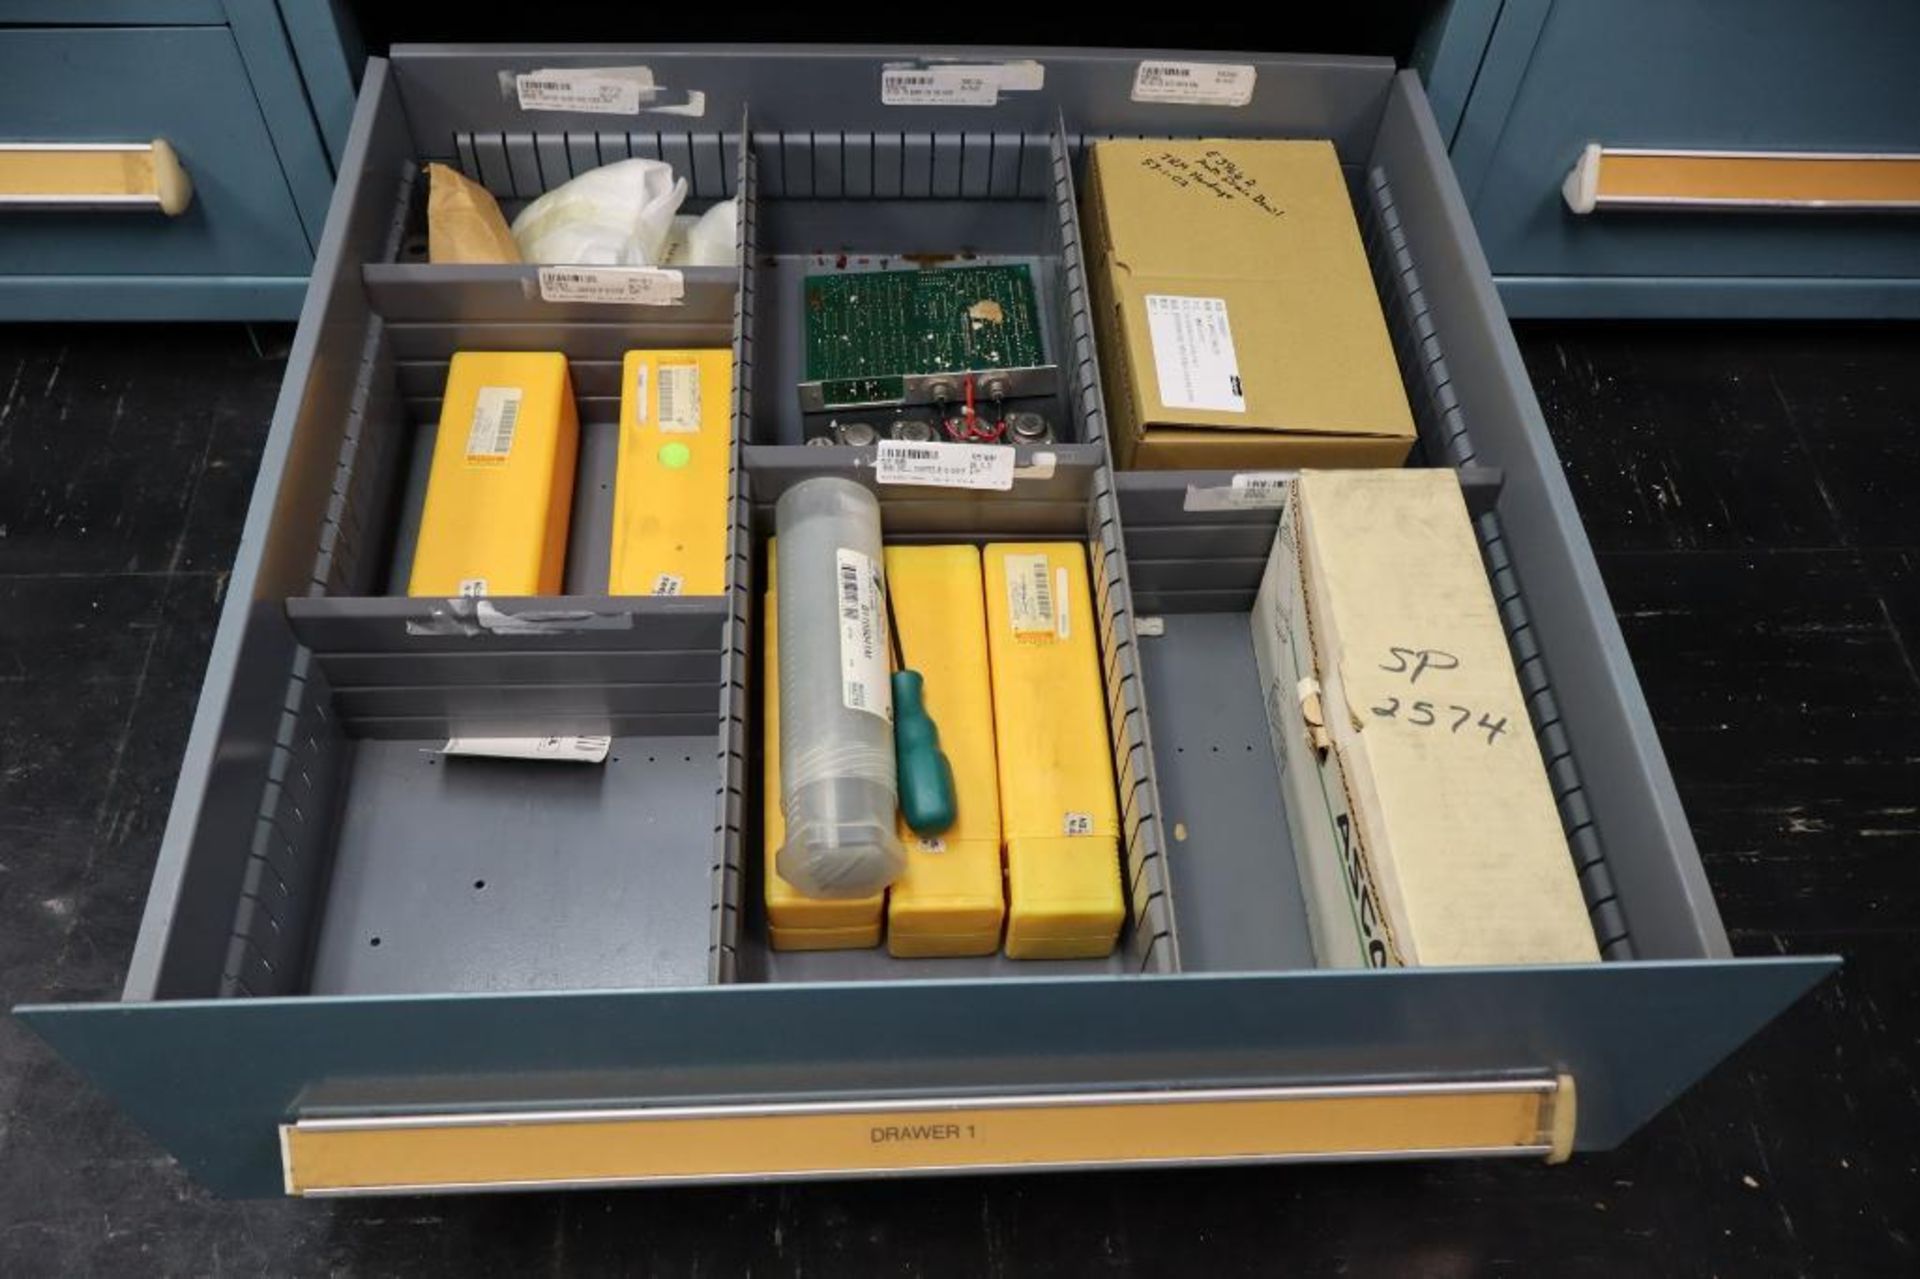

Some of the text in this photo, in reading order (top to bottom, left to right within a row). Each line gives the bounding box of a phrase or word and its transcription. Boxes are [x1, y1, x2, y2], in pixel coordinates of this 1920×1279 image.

[1378, 646, 1459, 684] SP
[1370, 697, 1508, 746] 2574
[870, 1124, 976, 1143] DRAWER 1
